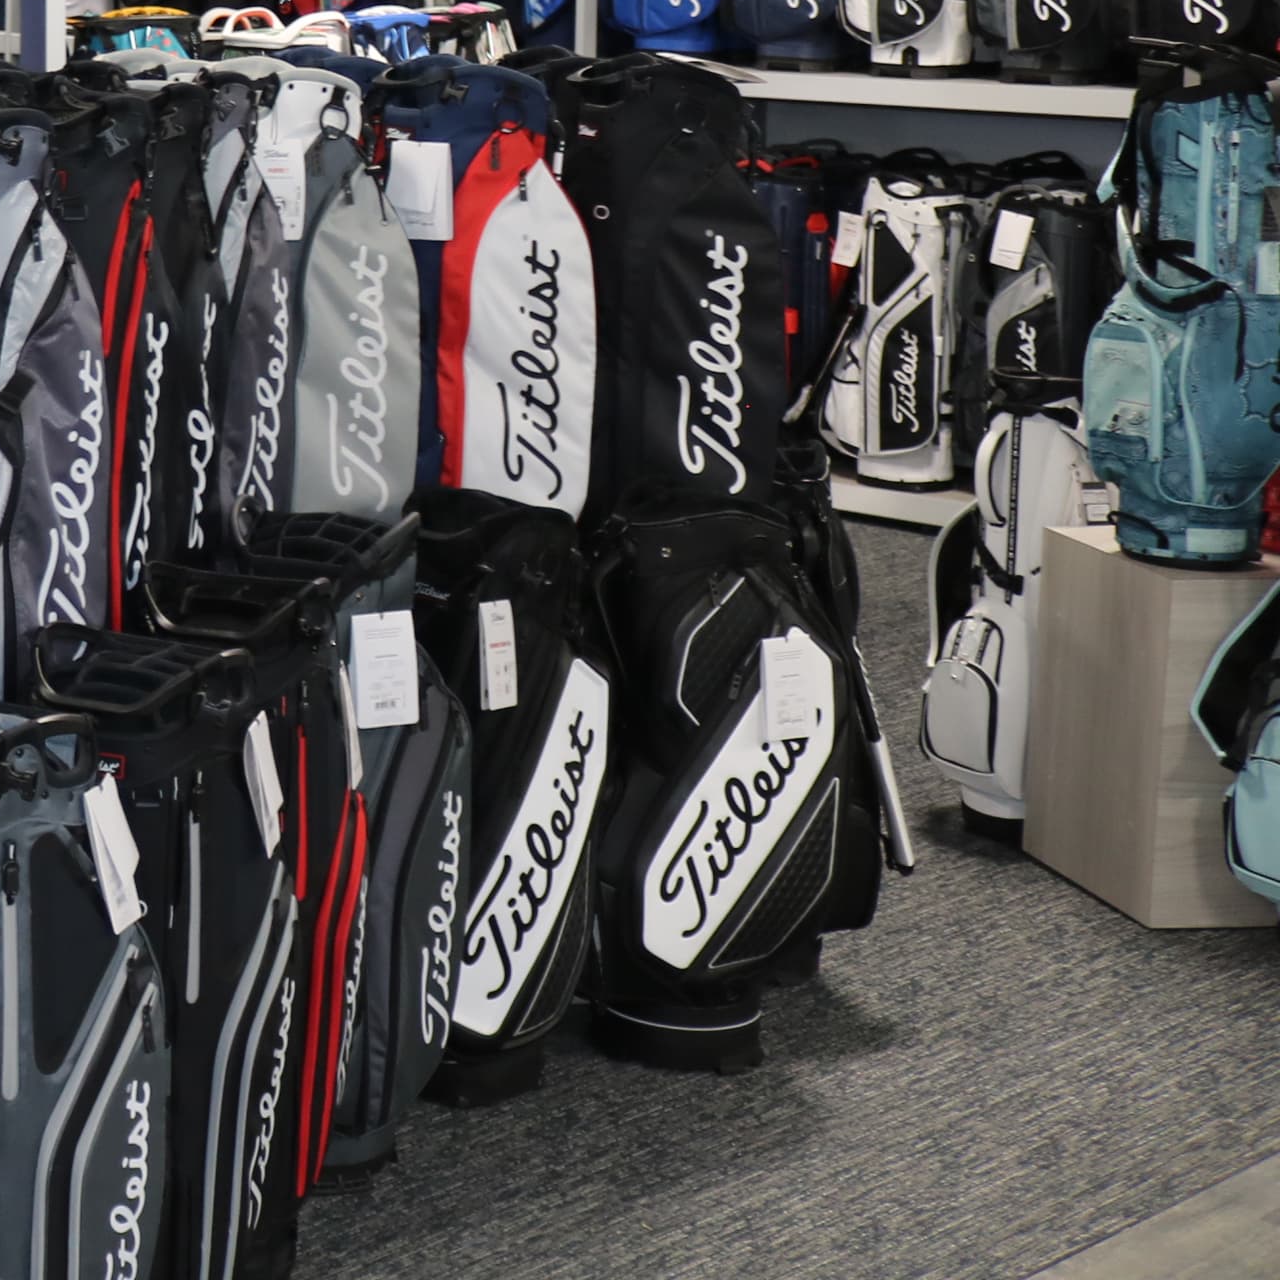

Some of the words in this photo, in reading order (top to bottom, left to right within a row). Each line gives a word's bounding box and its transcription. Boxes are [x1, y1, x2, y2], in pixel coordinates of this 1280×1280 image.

[328, 245, 389, 511] Titleist
[499, 239, 561, 501] Titleist
[678, 234, 748, 495] Titleist
[890, 328, 920, 433] Titleist
[422, 790, 464, 1048] Titleist
[462, 710, 594, 1000] Titleist
[660, 707, 822, 938] Titleis
